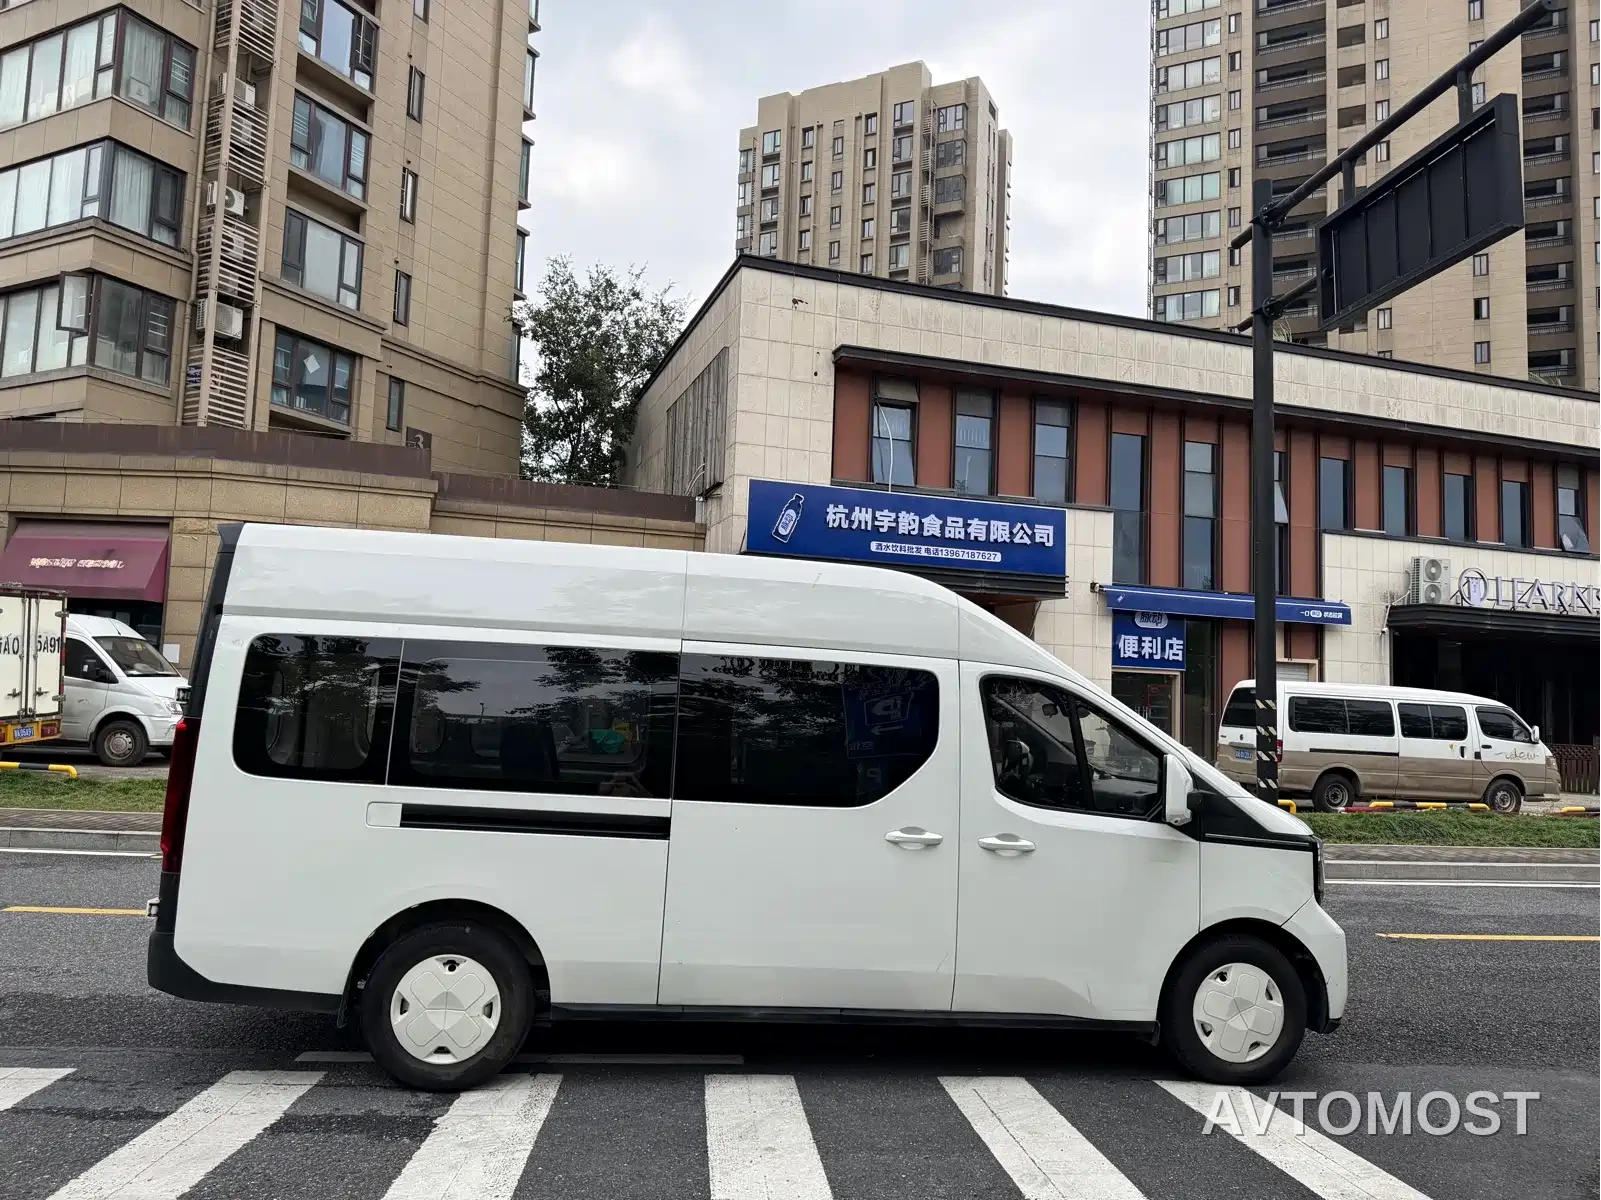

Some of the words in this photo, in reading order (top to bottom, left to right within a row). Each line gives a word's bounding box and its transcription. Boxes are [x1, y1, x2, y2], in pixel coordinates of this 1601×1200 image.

[826, 503, 1055, 547] 杭州宇韵食品有限公司
[874, 542, 922, 555] 酒水饮料批发
[924, 548, 998, 561] 电话13967187627
[1495, 576, 1600, 614] LEARN
[1118, 634, 1184, 661] 便利店
